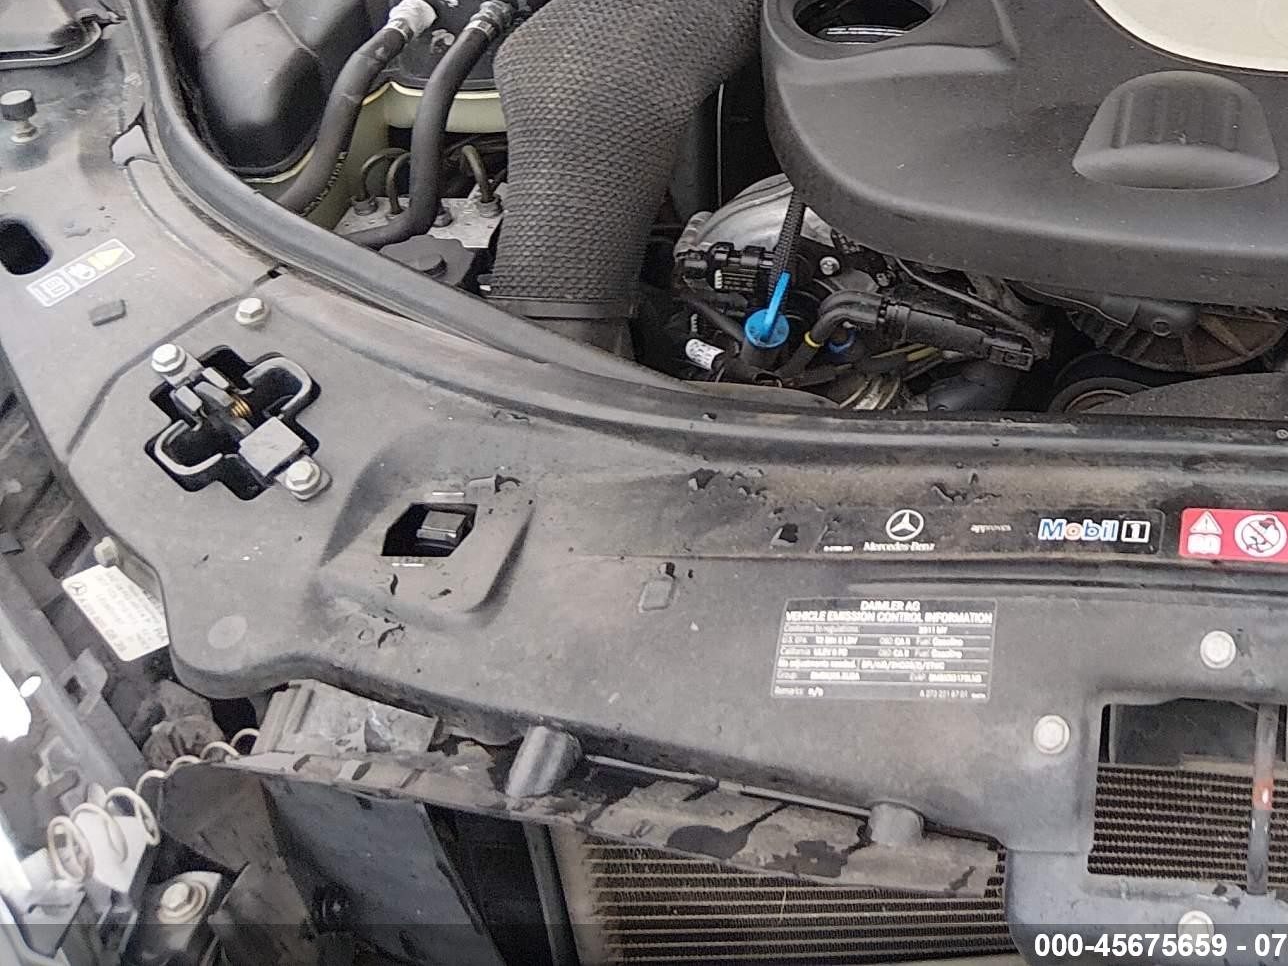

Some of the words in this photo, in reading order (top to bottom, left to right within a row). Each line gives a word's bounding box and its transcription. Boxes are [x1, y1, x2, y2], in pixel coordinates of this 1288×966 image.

[1038, 519, 1118, 541] Mobil
[863, 541, 936, 551] Mercedes-Benz
[860, 601, 904, 611] DAIMLER
[905, 601, 921, 611] AG
[786, 611, 827, 622] VEHICLE
[827, 611, 876, 622] EMISSION
[877, 611, 923, 623] CONTROL
[924, 612, 993, 623] INFORMATION
